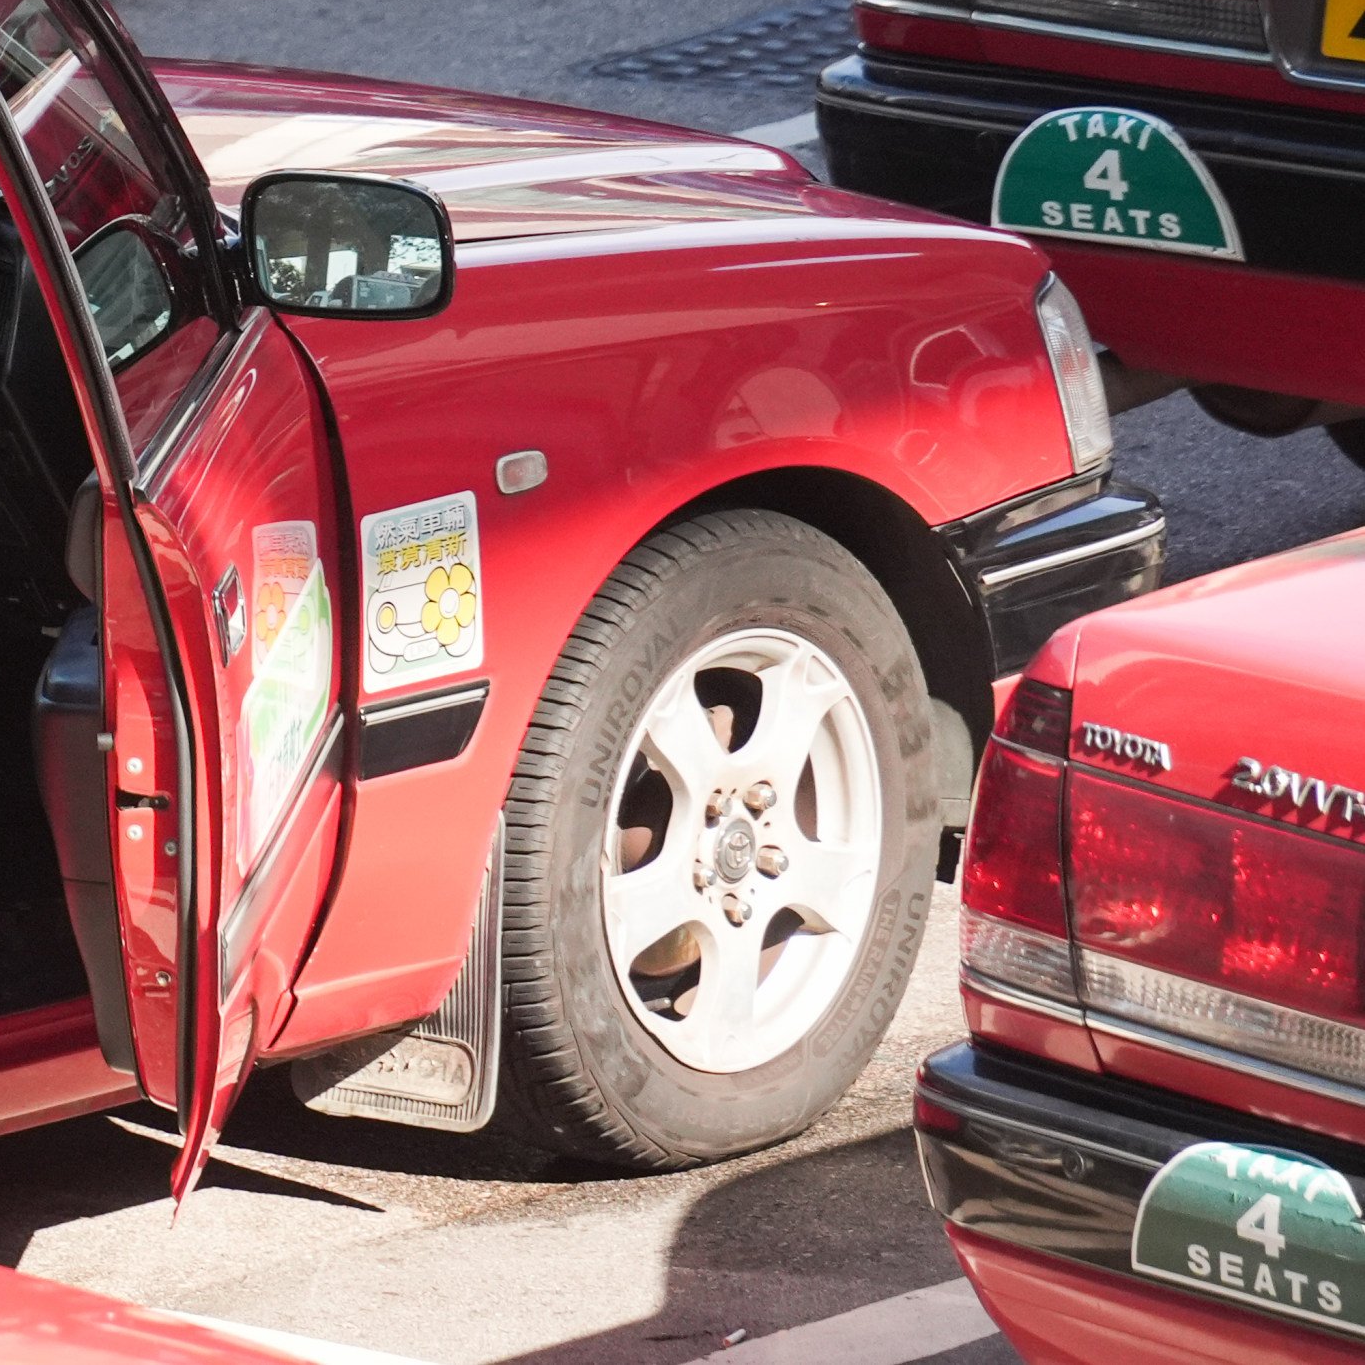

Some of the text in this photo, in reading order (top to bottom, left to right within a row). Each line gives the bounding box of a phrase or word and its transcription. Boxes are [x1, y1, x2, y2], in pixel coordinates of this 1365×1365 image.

[1058, 113, 1152, 151] TAXI
[1083, 149, 1130, 201] 4
[1041, 200, 1182, 239] SEATS
[1082, 721, 1172, 771] TOYOTA
[1236, 1192, 1286, 1259] 4
[1186, 1243, 1342, 1314] SEATS
